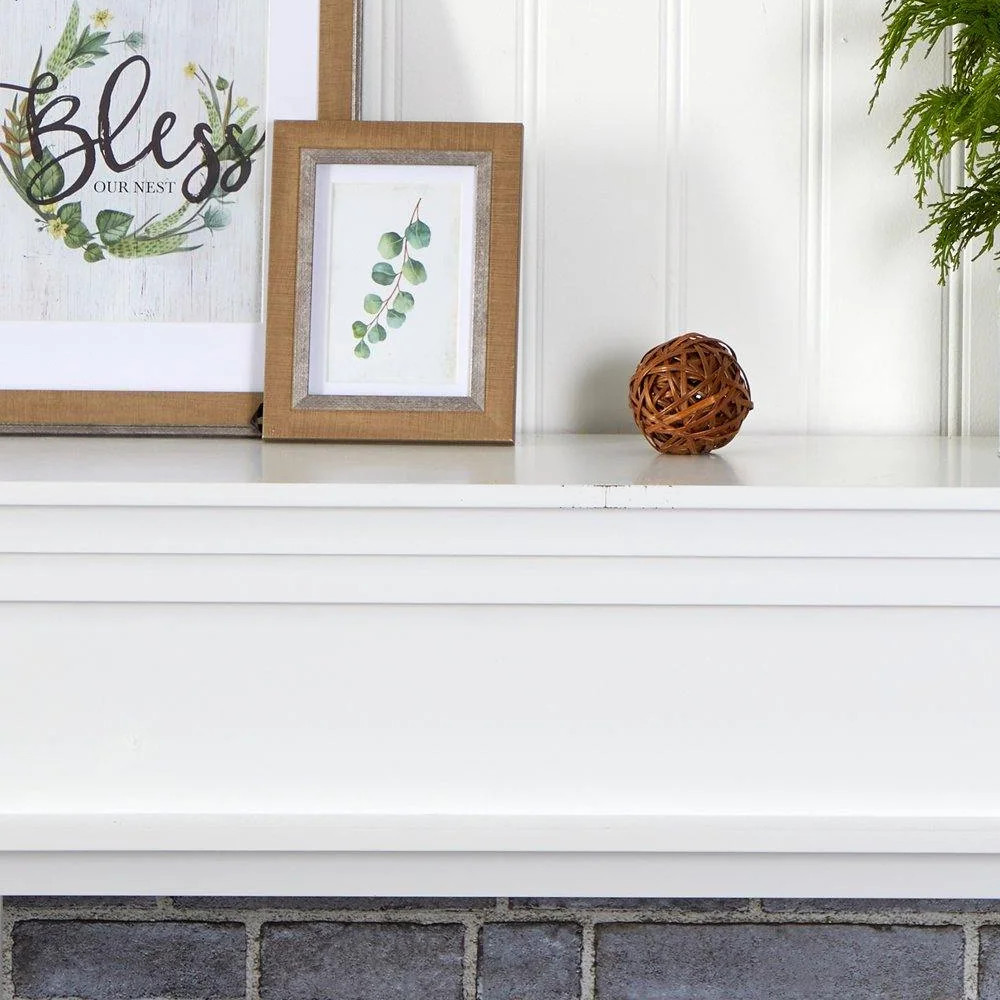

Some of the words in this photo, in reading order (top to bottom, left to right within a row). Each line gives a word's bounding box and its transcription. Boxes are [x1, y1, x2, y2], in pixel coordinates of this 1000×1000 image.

[0, 55, 265, 204] Bless
[93, 181, 129, 194] OUR
[133, 181, 176, 194] NEST
